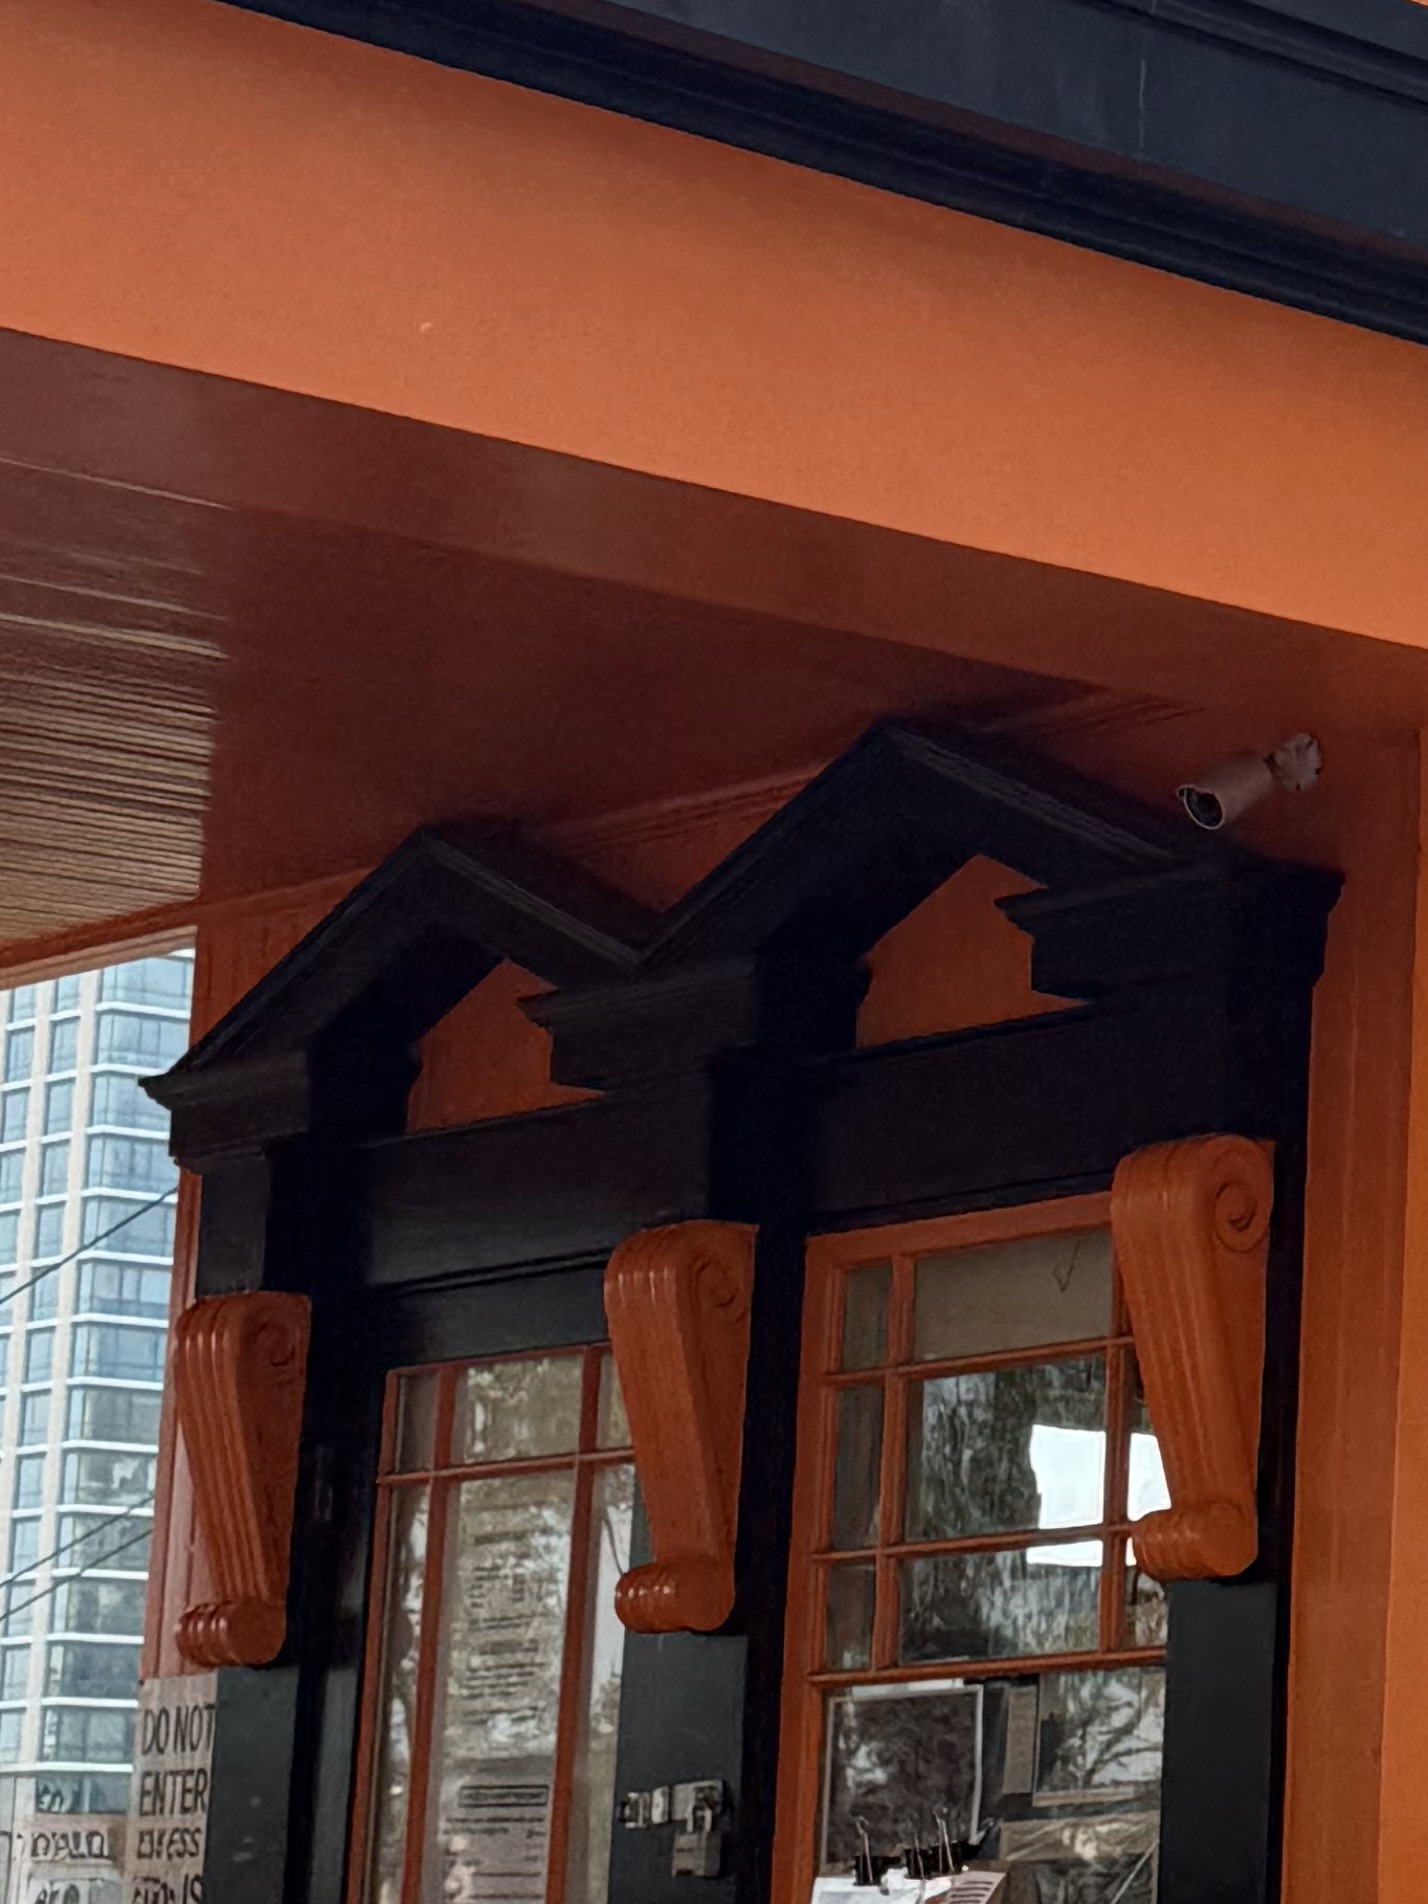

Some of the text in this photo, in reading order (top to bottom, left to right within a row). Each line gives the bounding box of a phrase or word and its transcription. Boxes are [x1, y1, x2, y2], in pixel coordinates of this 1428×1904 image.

[141, 1703, 216, 1756] DO NOT
[138, 1767, 209, 1817] ENTER
